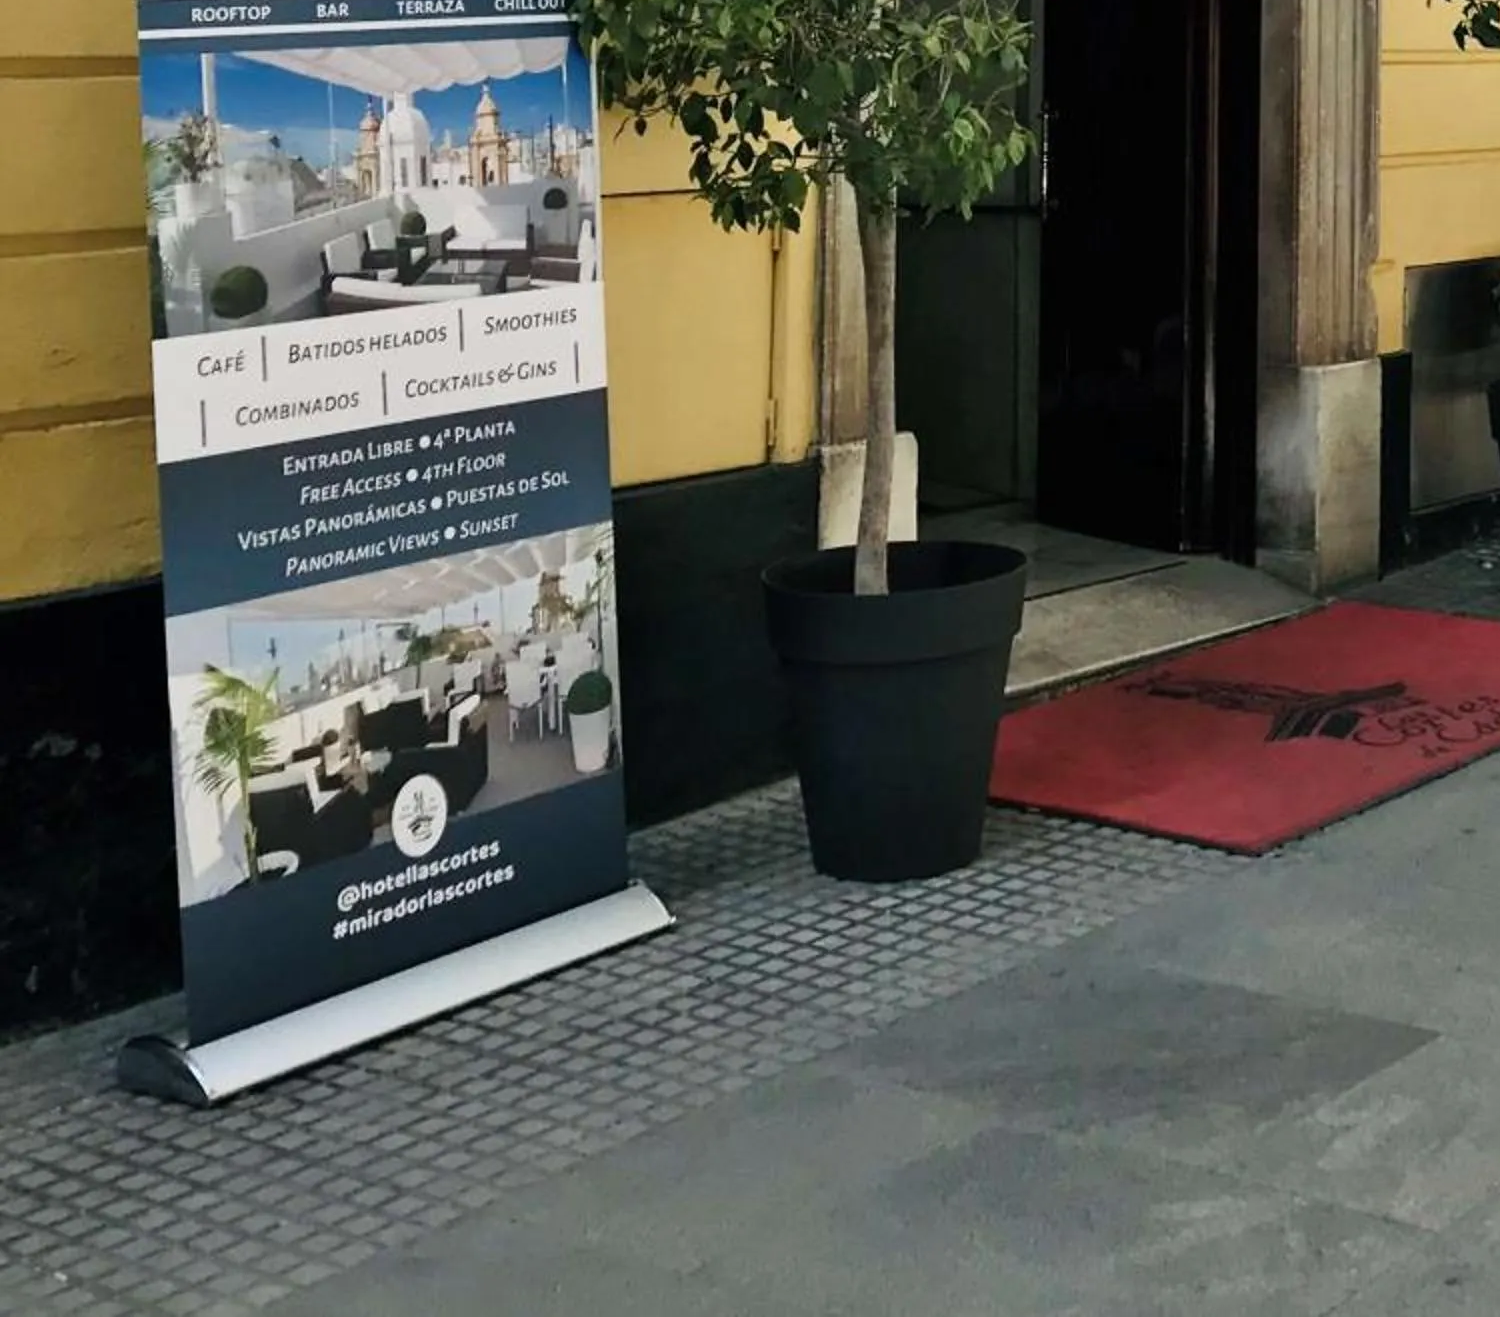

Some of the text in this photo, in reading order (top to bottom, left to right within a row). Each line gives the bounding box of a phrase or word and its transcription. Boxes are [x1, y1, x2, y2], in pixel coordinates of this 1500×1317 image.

[191, 5, 272, 23] ROOFTOP
[316, 1, 349, 18] BAR
[484, 307, 578, 336] SMOOTHIES
[197, 349, 246, 378] CAFÉ
[288, 325, 449, 365] BATIDOS HELADOS
[404, 371, 495, 399] COCKTAILS
[517, 360, 558, 381] GINS
[235, 390, 360, 427] COMBINADOS
[283, 445, 364, 477] ENTRADA
[368, 435, 414, 459] LIBRE
[454, 419, 517, 446] PLANTA
[300, 451, 507, 507] FREE ACCESS 4TH FLOOR
[238, 471, 570, 552] VISTAS PANORÁMICAS PUESTAS DE SOL
[285, 512, 518, 578] PANORAMIC VIEWS SUNSET
[337, 839, 501, 912] @hotellascortes
[332, 863, 516, 939] #miradorlascortes
